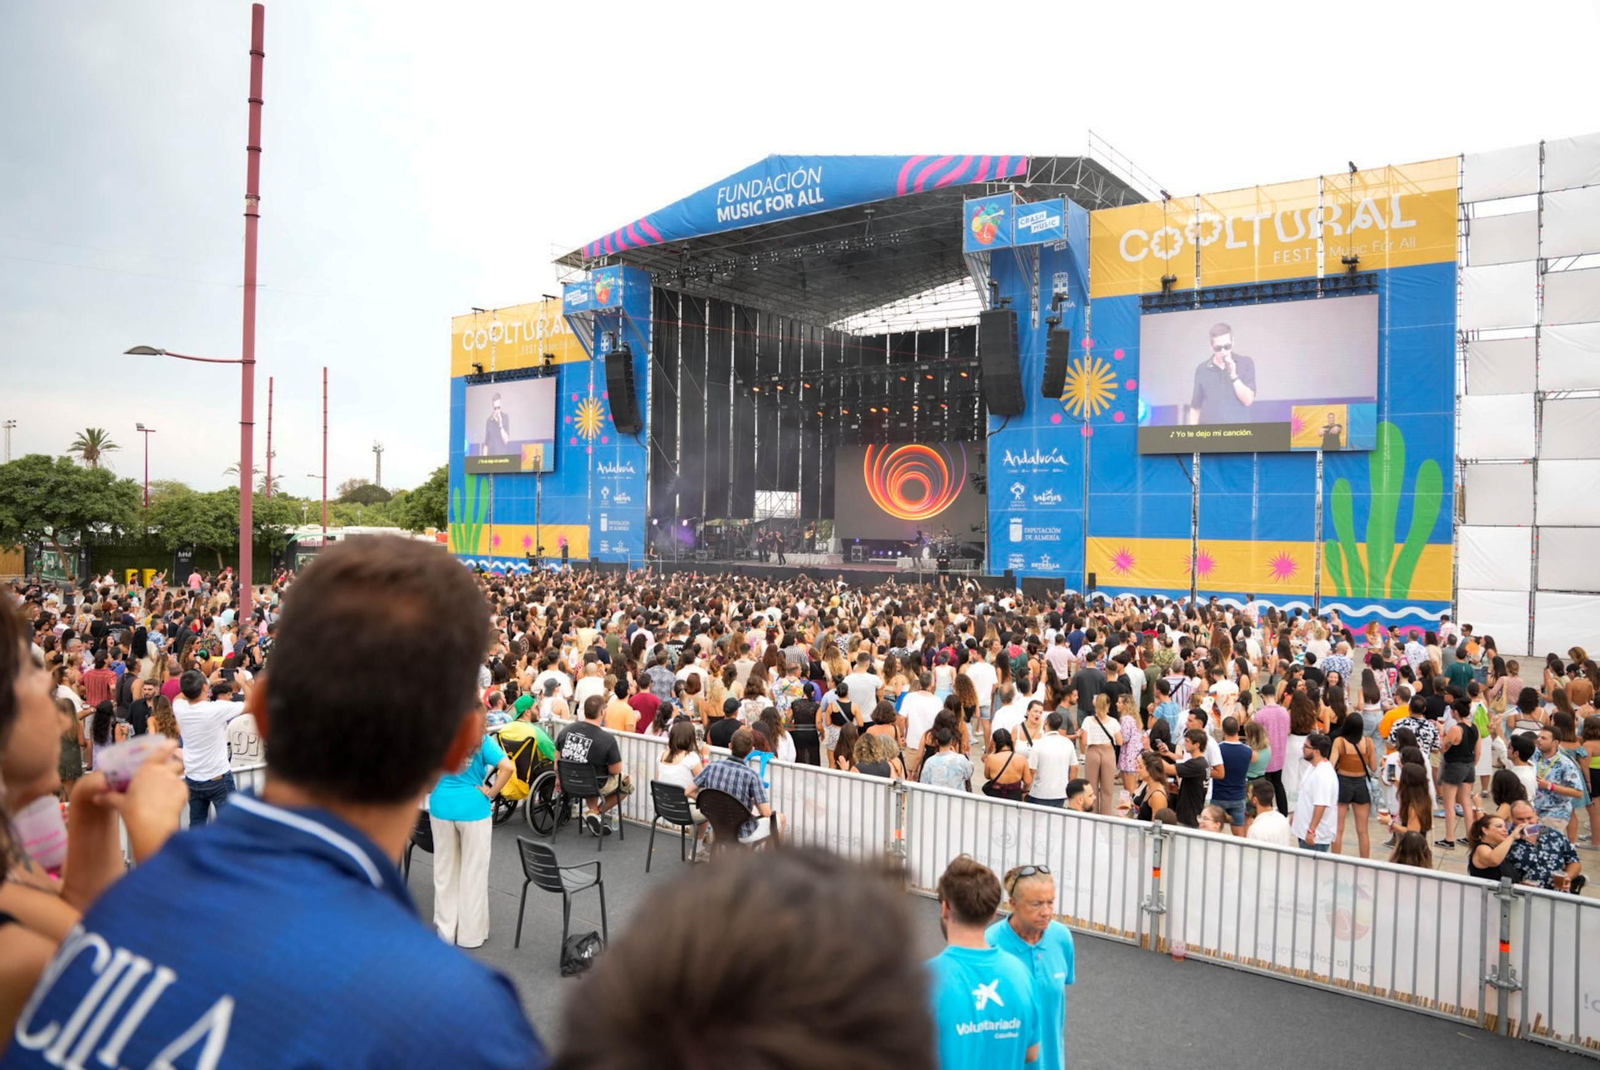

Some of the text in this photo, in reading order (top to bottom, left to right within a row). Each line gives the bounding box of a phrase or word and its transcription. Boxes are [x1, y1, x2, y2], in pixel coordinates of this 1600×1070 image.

[717, 165, 822, 205] FUNDACIÓN
[716, 187, 825, 223] MUSIC FOR ALL
[1020, 212, 1045, 225] CRASH
[1033, 220, 1057, 231] MUSIC
[1118, 192, 1417, 263] COOLTURAL
[1273, 236, 1417, 264] FEST Music For All
[1196, 430, 1211, 439] dejo
[1003, 448, 1069, 466] Andalucía
